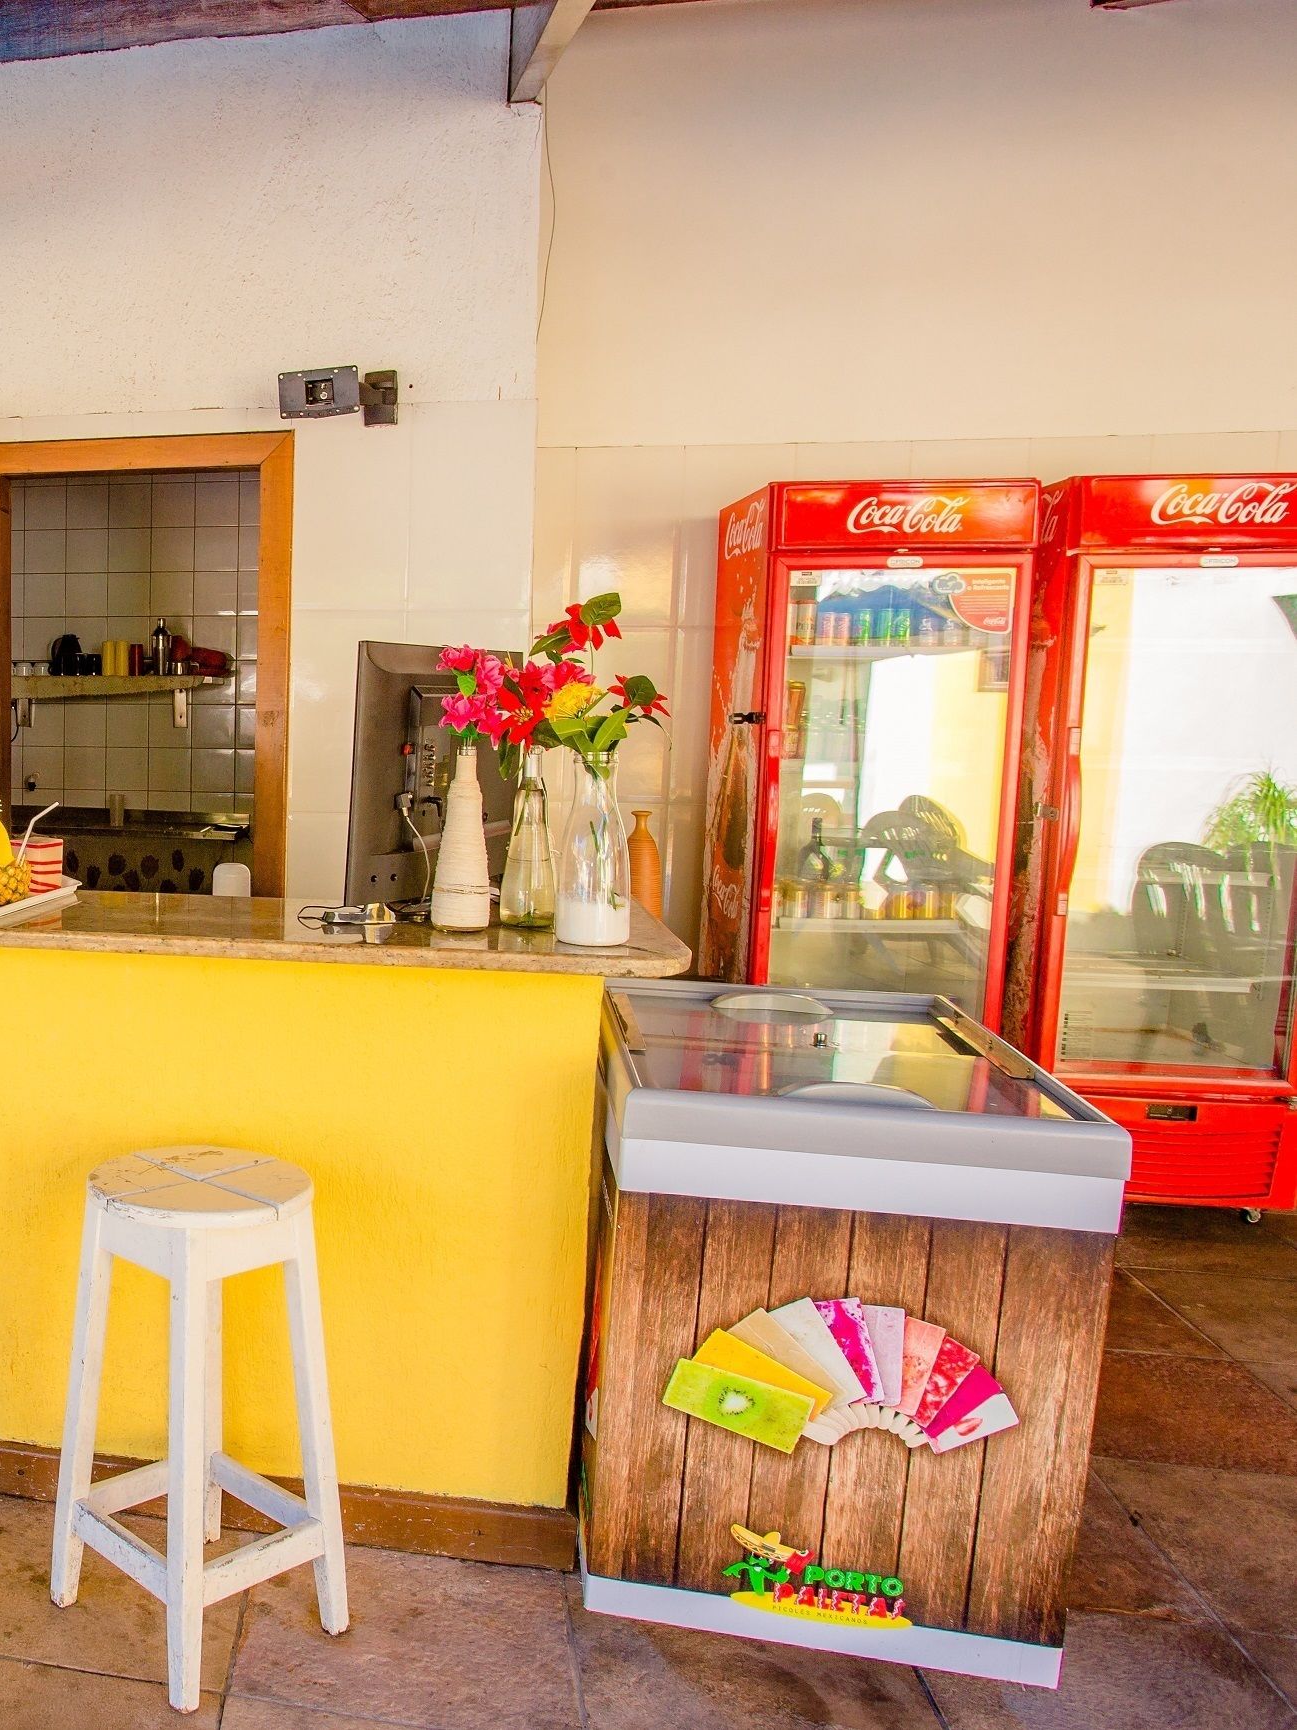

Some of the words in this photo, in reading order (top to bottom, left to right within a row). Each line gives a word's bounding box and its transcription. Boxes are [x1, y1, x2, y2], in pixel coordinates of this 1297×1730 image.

[846, 496, 971, 534] Coca-Cola
[1150, 482, 1297, 525] Coca-Cola
[804, 1565, 904, 1597] PORTO
[774, 1583, 906, 1619] PALETAS
